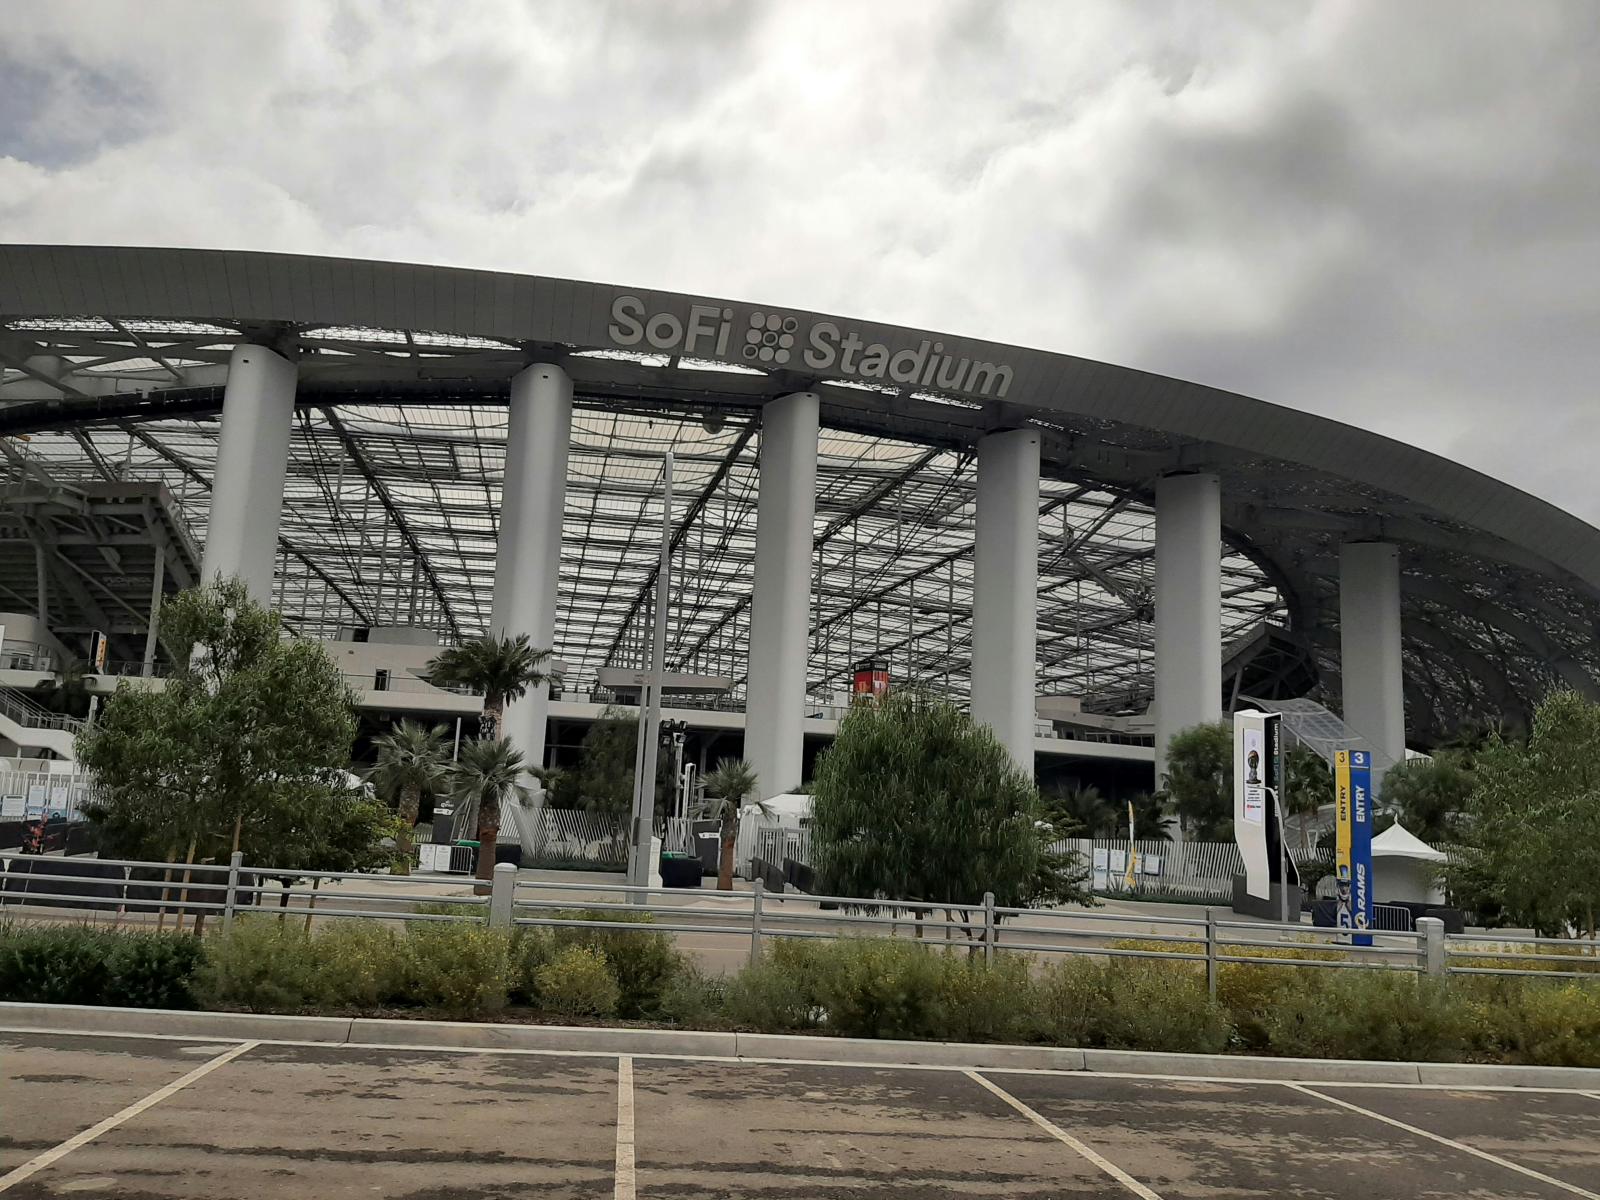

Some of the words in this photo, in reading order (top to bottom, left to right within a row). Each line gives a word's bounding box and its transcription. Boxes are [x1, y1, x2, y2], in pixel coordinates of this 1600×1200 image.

[608, 295, 733, 356] SoFi
[803, 322, 1014, 397] Stadium
[1338, 752, 1346, 763] 3
[1354, 752, 1364, 764] 3
[1356, 785, 1365, 823] ENTRY
[1357, 863, 1365, 910] RAMS
